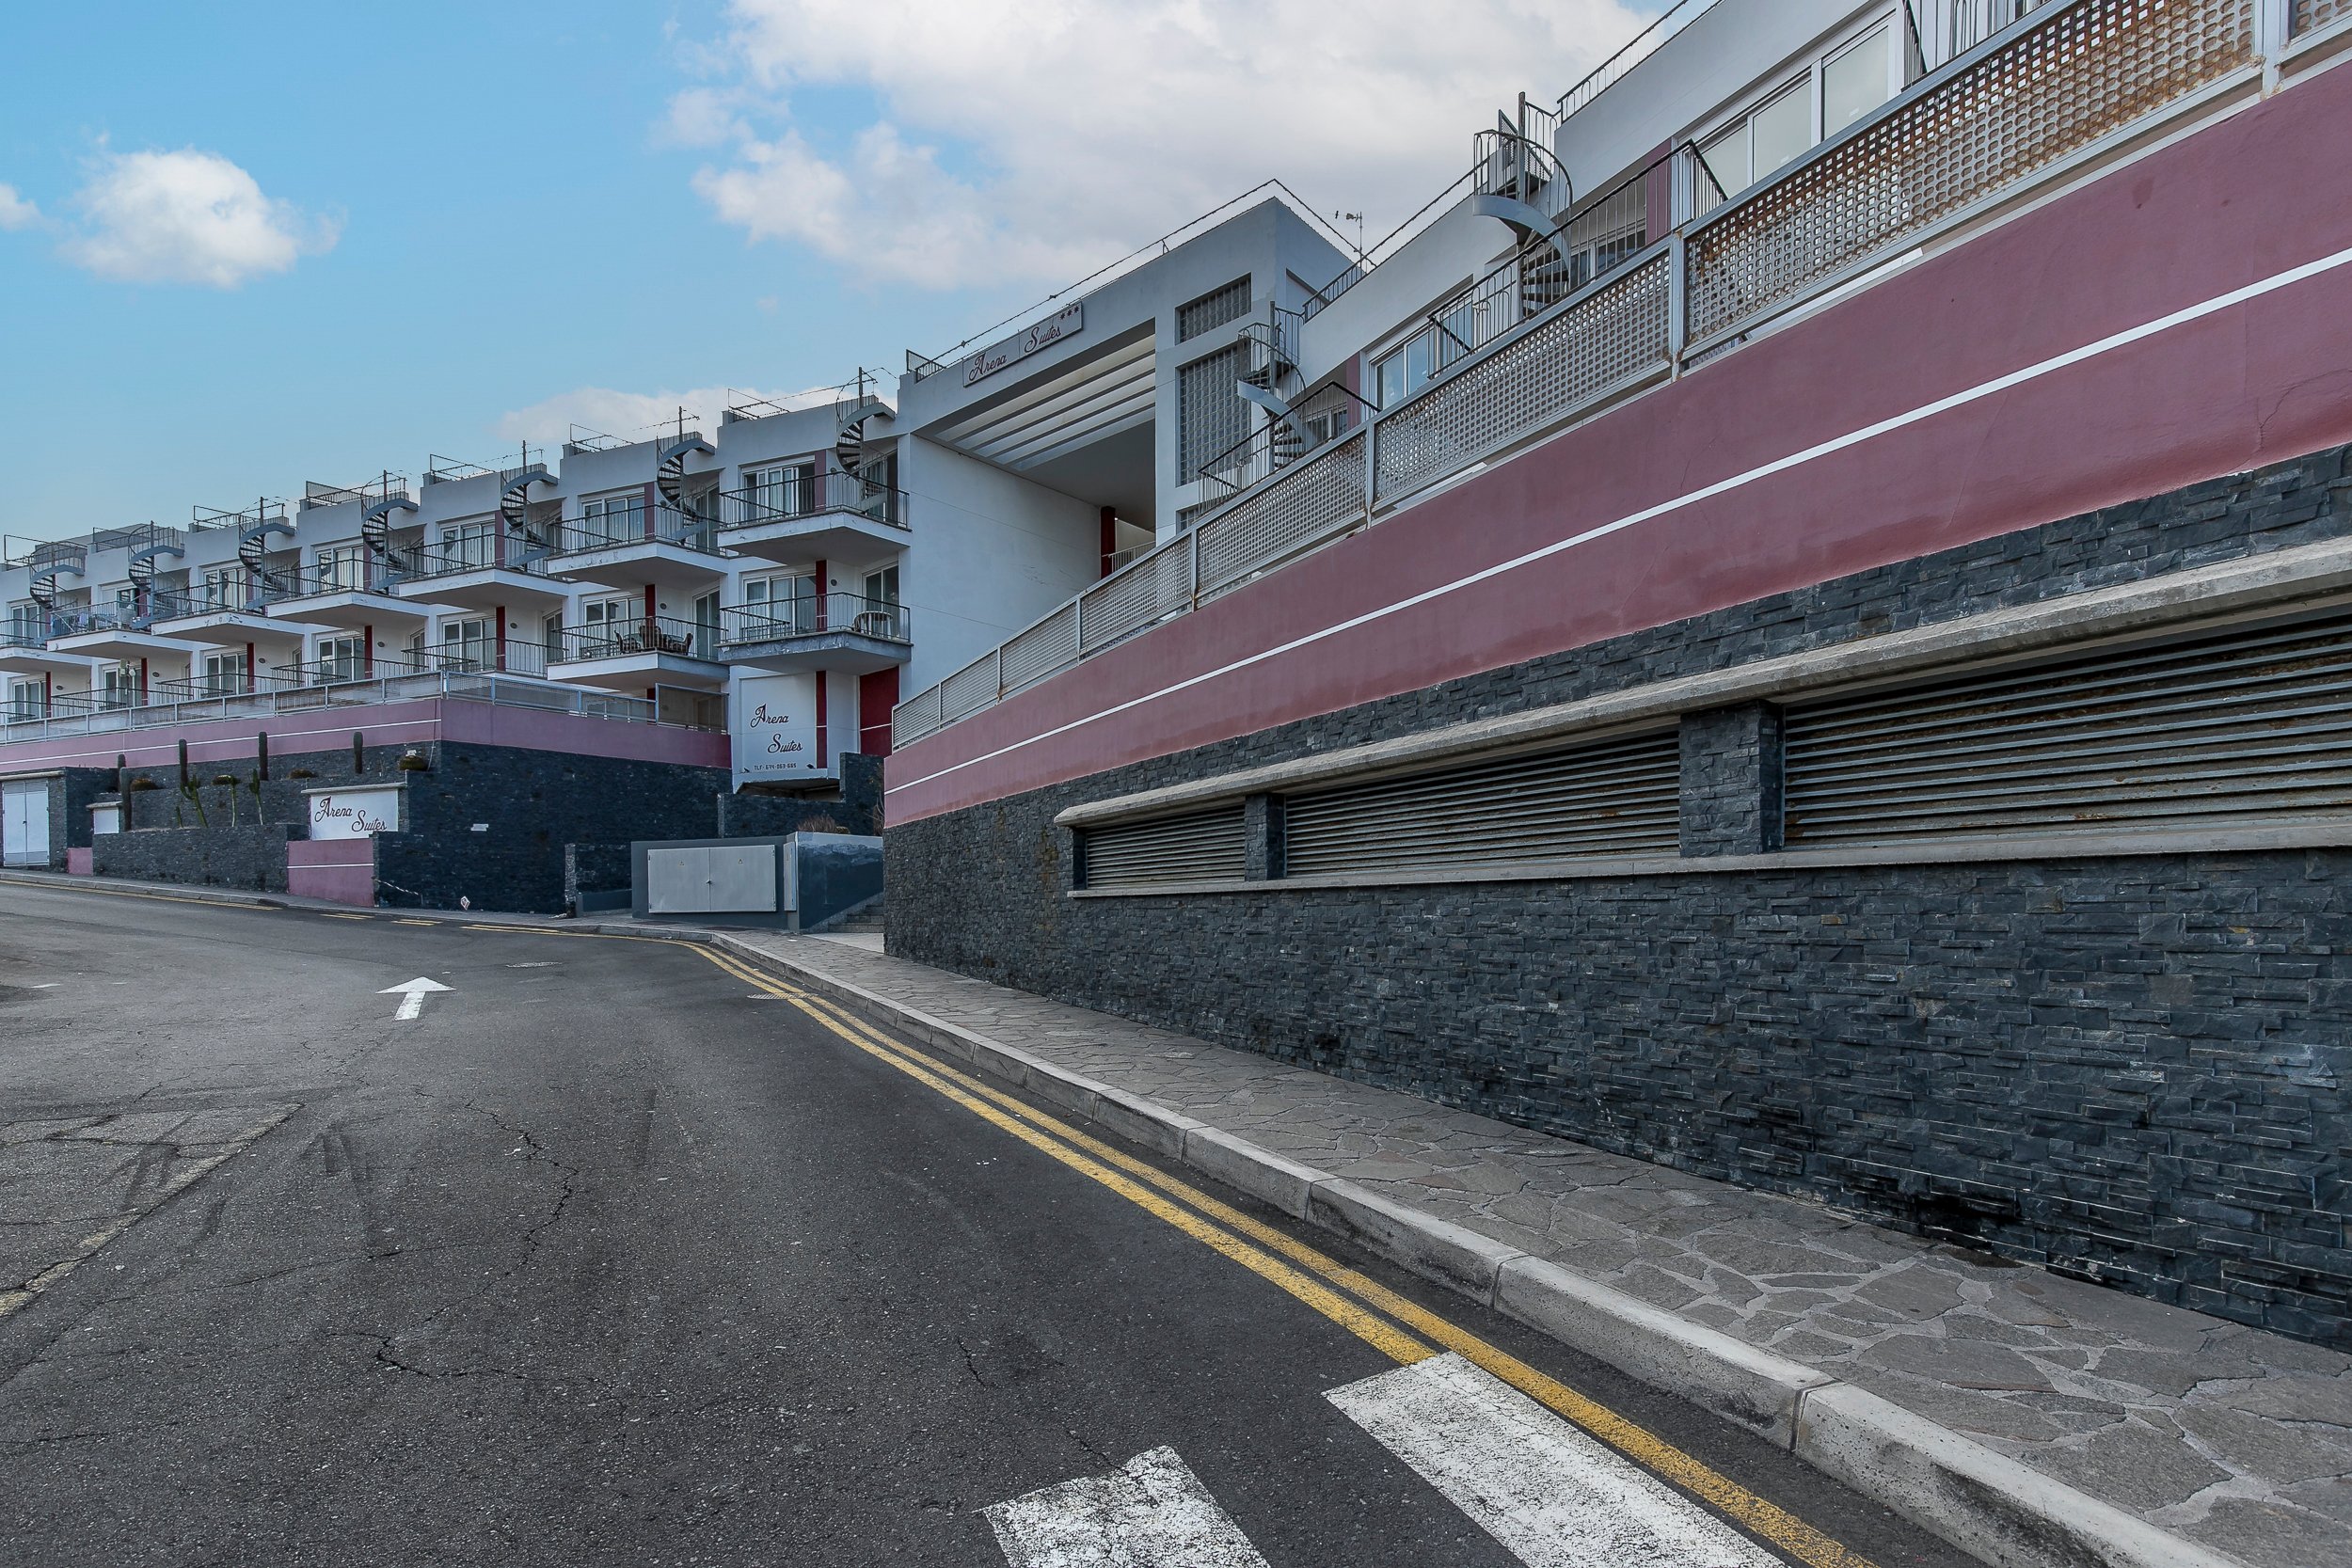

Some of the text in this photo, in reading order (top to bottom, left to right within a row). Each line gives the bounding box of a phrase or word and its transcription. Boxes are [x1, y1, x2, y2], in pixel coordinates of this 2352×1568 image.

[969, 325, 1061, 381] Arena Suites
[750, 704, 788, 728] Arena
[767, 734, 803, 753] Suites
[314, 796, 387, 832] Arena Suites
